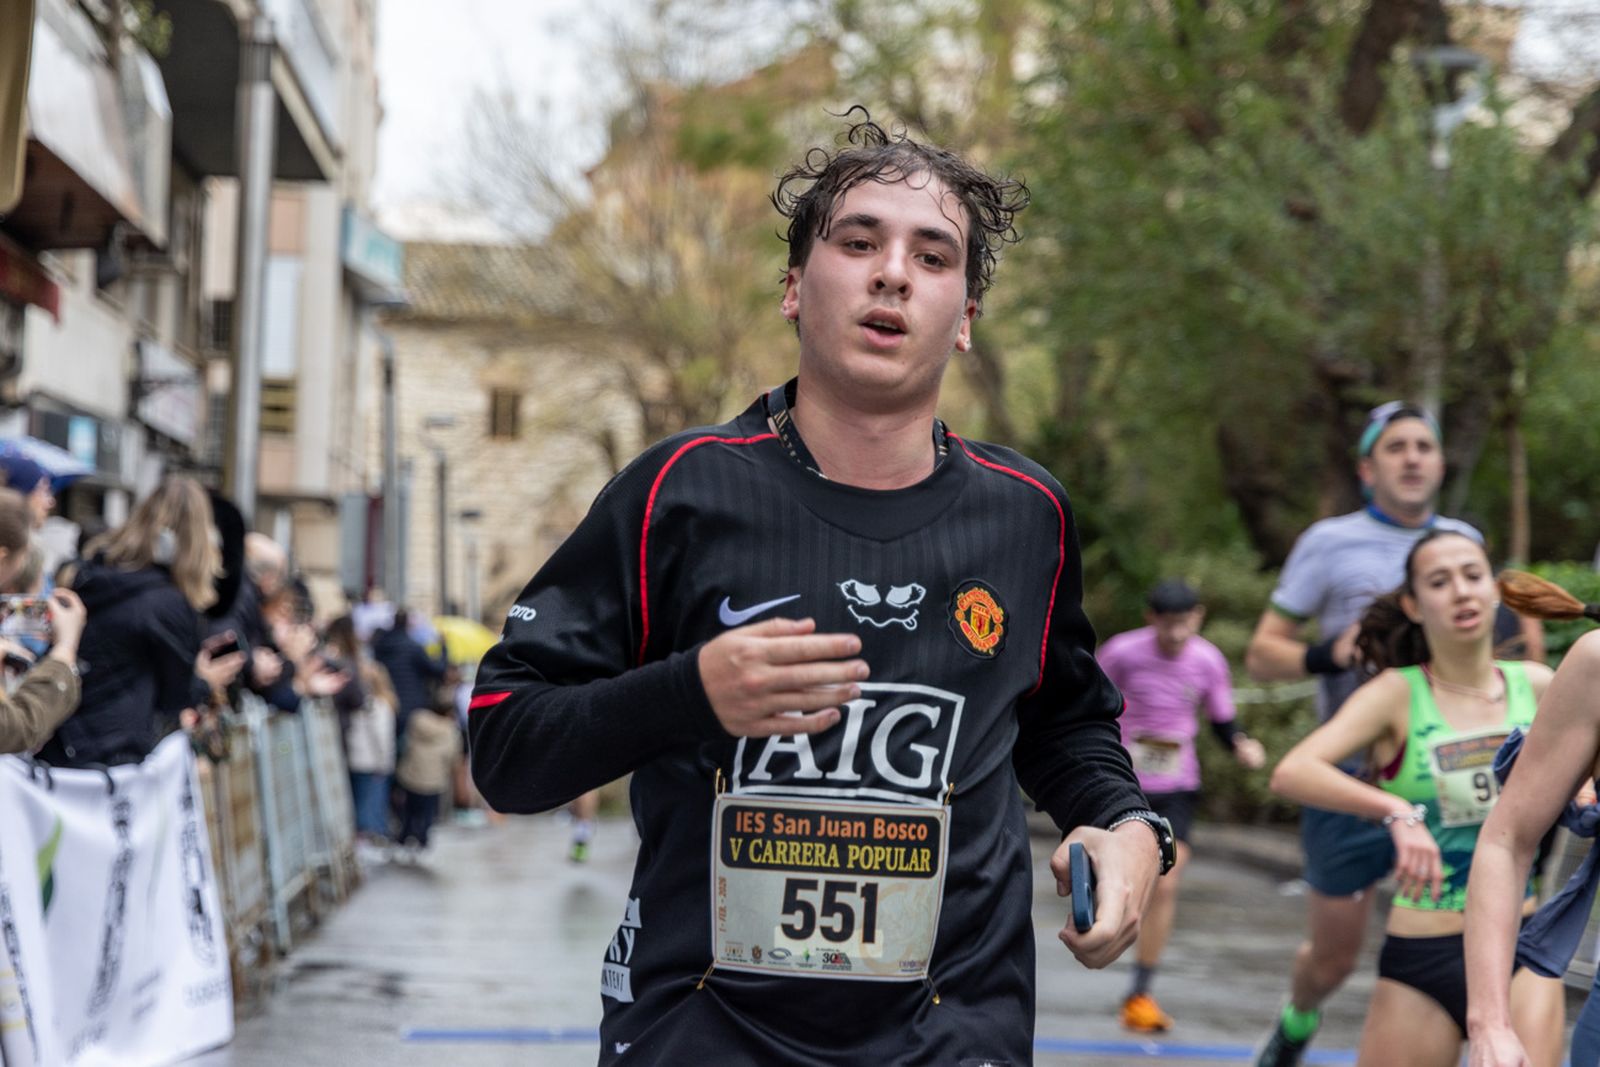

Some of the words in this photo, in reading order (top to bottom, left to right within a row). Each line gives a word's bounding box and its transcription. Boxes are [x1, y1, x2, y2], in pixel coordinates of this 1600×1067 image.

[747, 698, 941, 789] AIG
[735, 811, 766, 834] IES
[772, 813, 811, 836] San
[816, 815, 866, 838] Juan
[873, 818, 928, 841] Bosco
[729, 837, 743, 861] V
[748, 838, 840, 868] CARRERA
[846, 844, 932, 872] POPULAR
[780, 877, 879, 944] 551
